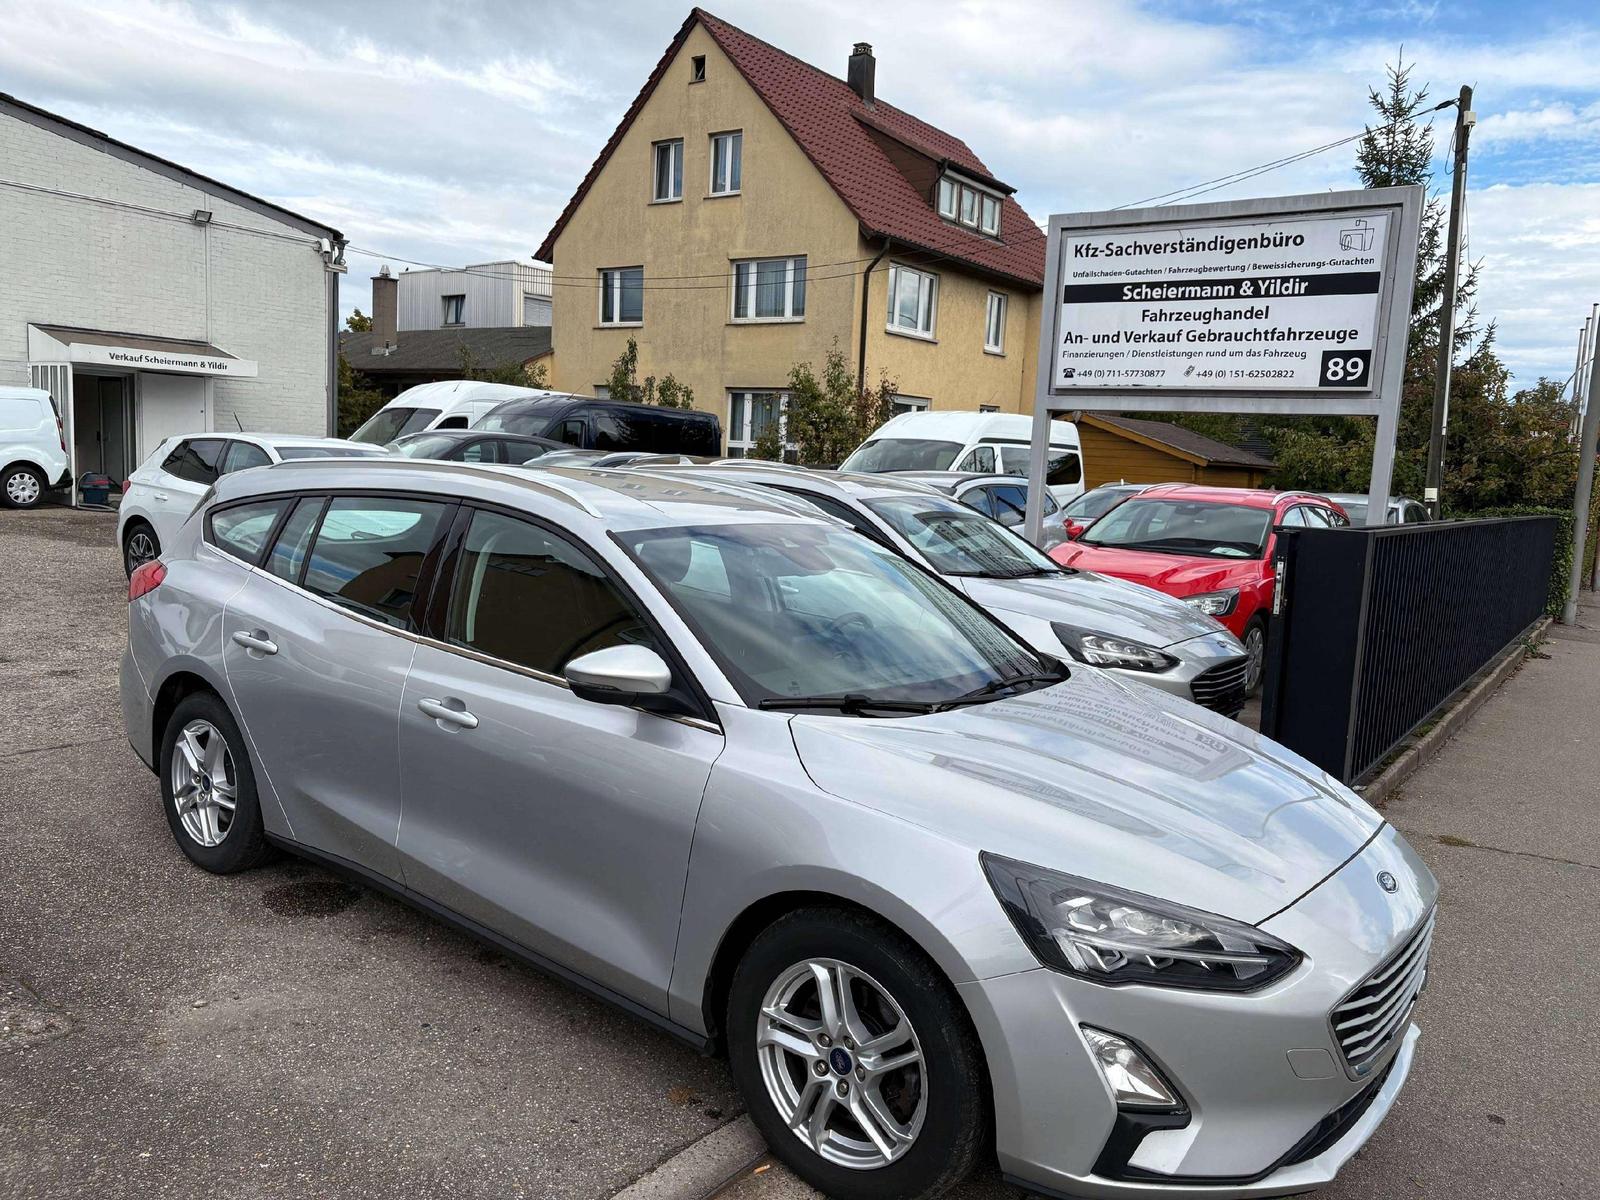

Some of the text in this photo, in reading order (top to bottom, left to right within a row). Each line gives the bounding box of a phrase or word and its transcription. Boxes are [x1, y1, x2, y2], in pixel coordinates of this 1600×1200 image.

[1074, 232, 1304, 258] Kfz-Sachverständigenbüro
[1073, 267, 1163, 278] Unfallschaden-Gutachten
[1168, 264, 1245, 275] Fahrzeugbewertung
[1252, 257, 1375, 270] Beweissicherungs-Gutachten
[1122, 278, 1309, 300] Scheiermann & Yildir
[1141, 305, 1270, 325] Fahrzeughandel
[1063, 327, 1359, 344] An- und Verkauf Gebrauchtfahrzeuge
[109, 352, 143, 363] Verkauf
[145, 355, 198, 367] Scheiermann
[207, 361, 228, 370] Yildir
[1062, 350, 1125, 360] Finanzierungen
[1131, 349, 1203, 359] Dienstleistungen
[1205, 349, 1227, 357] rund
[1245, 349, 1262, 358] das
[1263, 349, 1307, 360] Fahrzeug
[1076, 369, 1166, 379] +49 (0) 711-57730877
[1196, 369, 1295, 379] +49 (0) 151-62502822
[1326, 357, 1364, 381] 89
